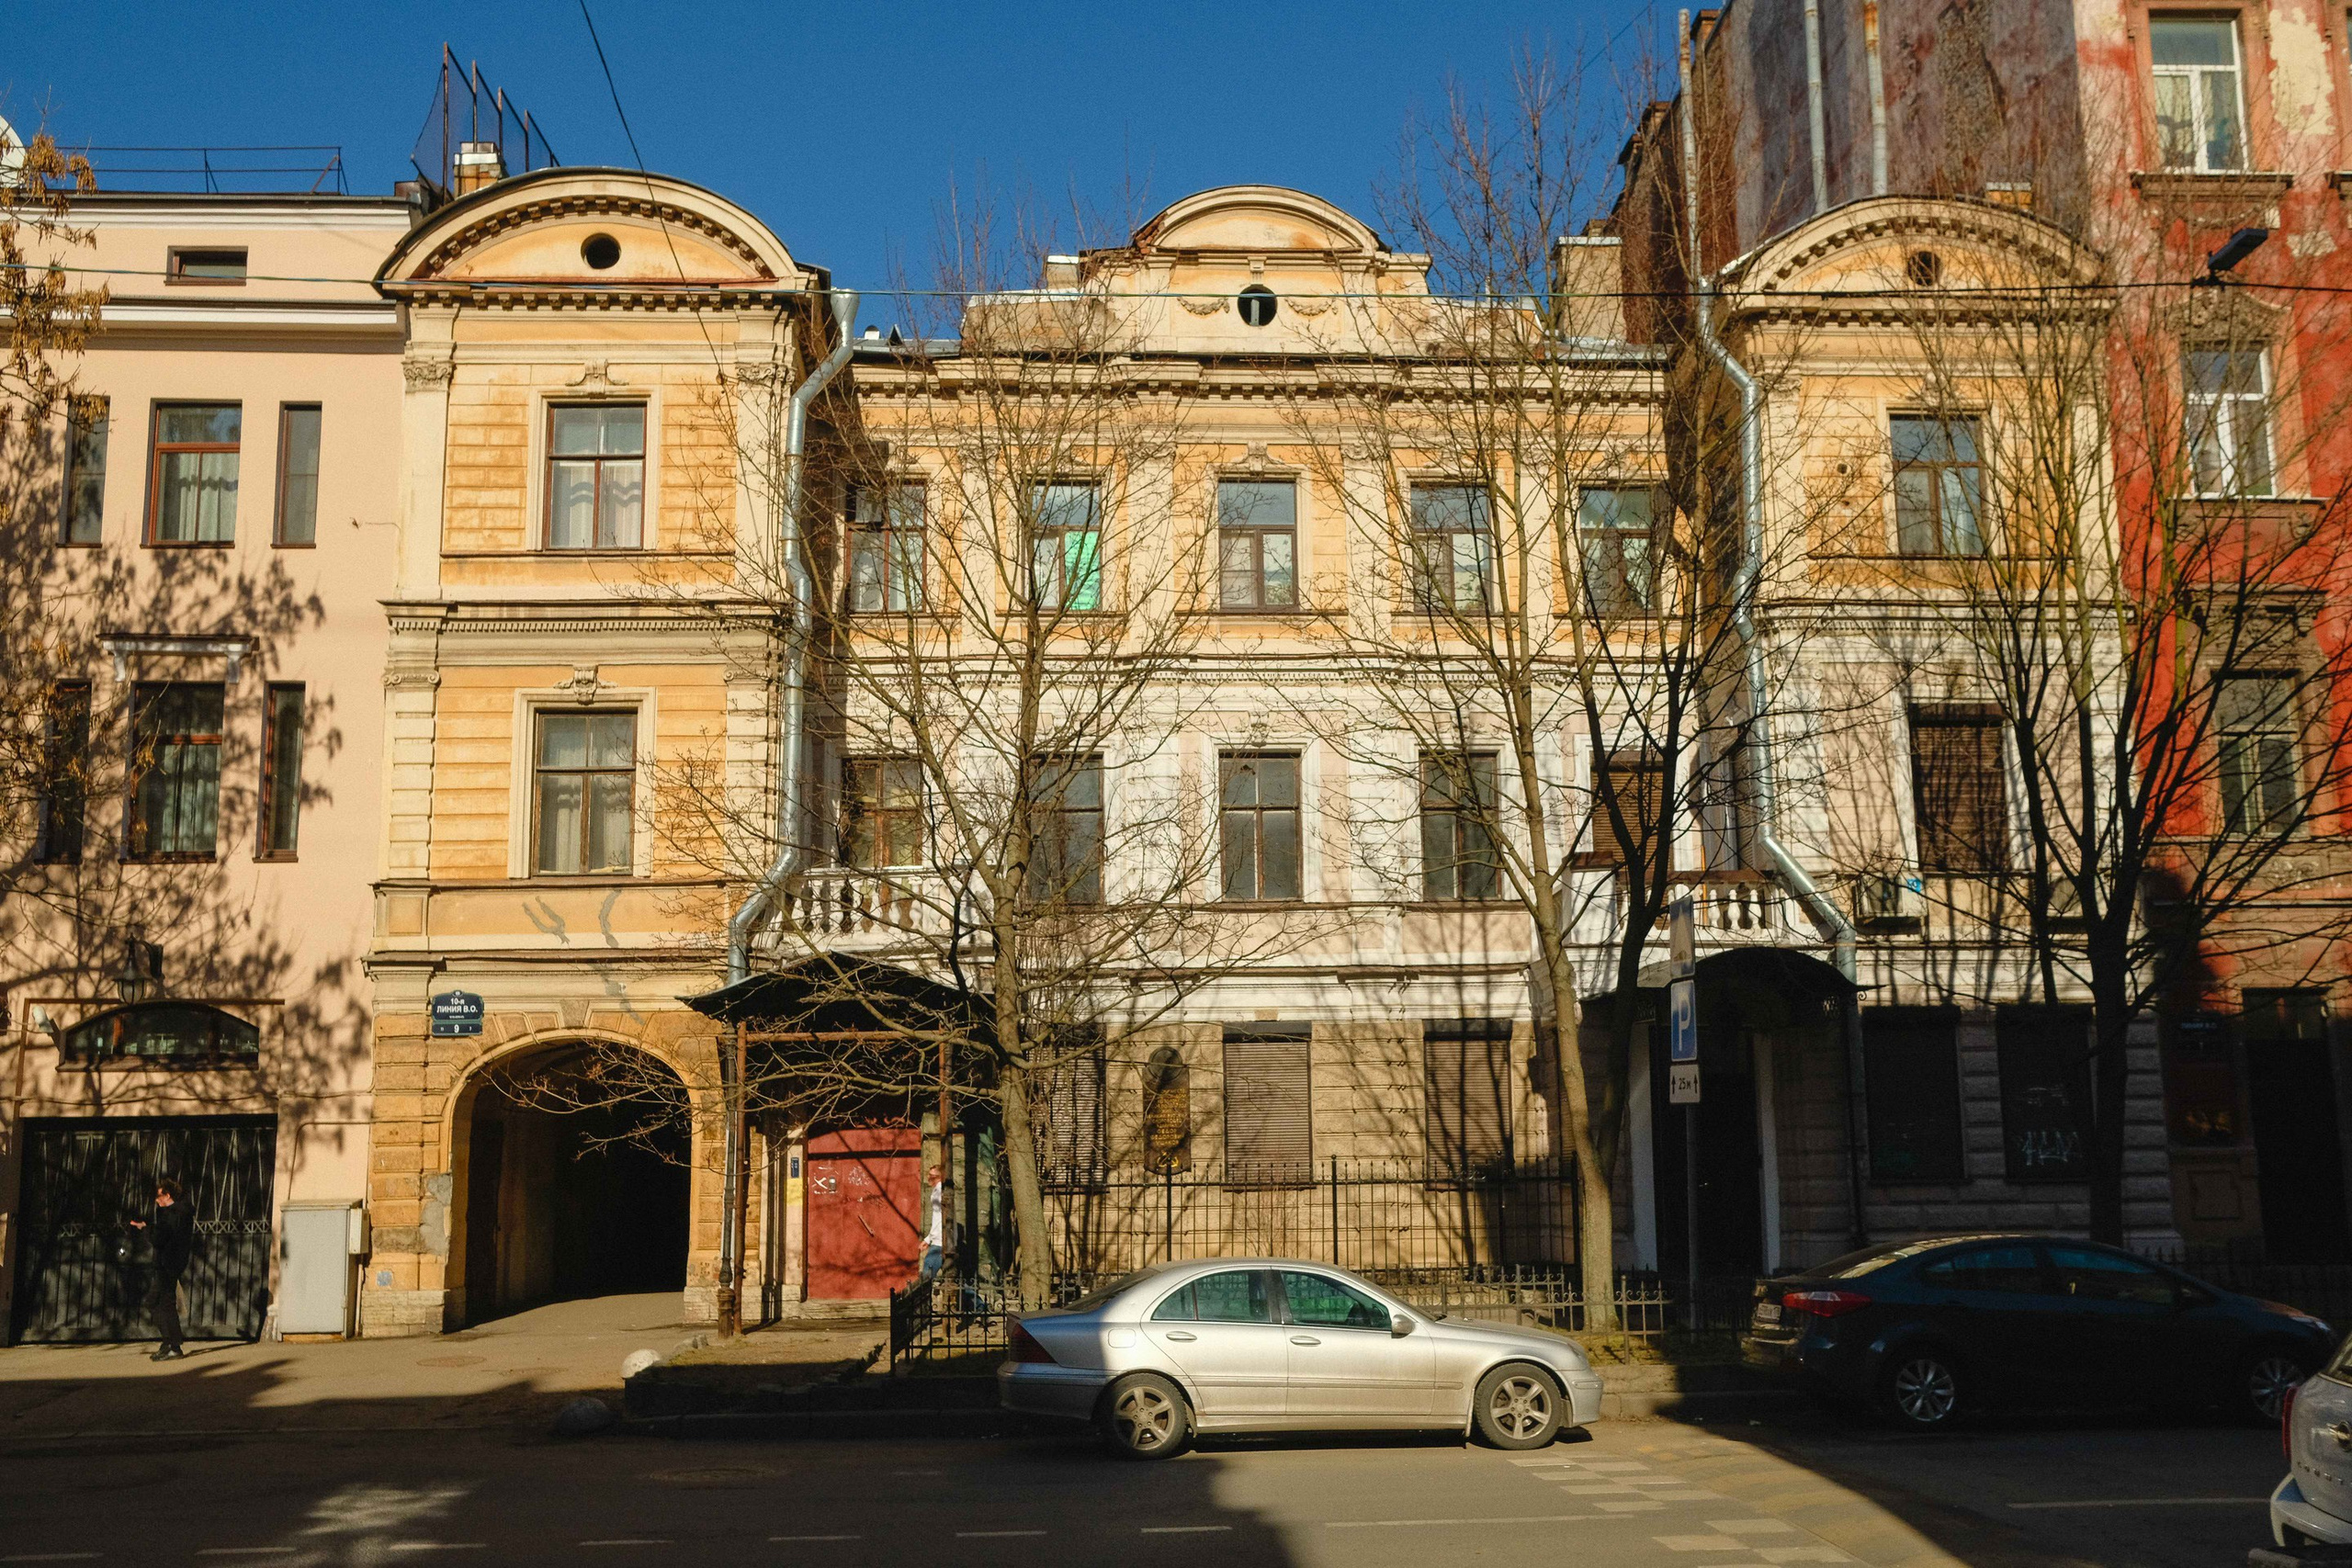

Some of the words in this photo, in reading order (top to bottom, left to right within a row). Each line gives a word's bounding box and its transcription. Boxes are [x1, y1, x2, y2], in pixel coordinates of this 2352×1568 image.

[436, 1005, 462, 1013] ЛИНИЯ
[463, 1005, 478, 1013] В.О.
[454, 1023, 459, 1033] 9
